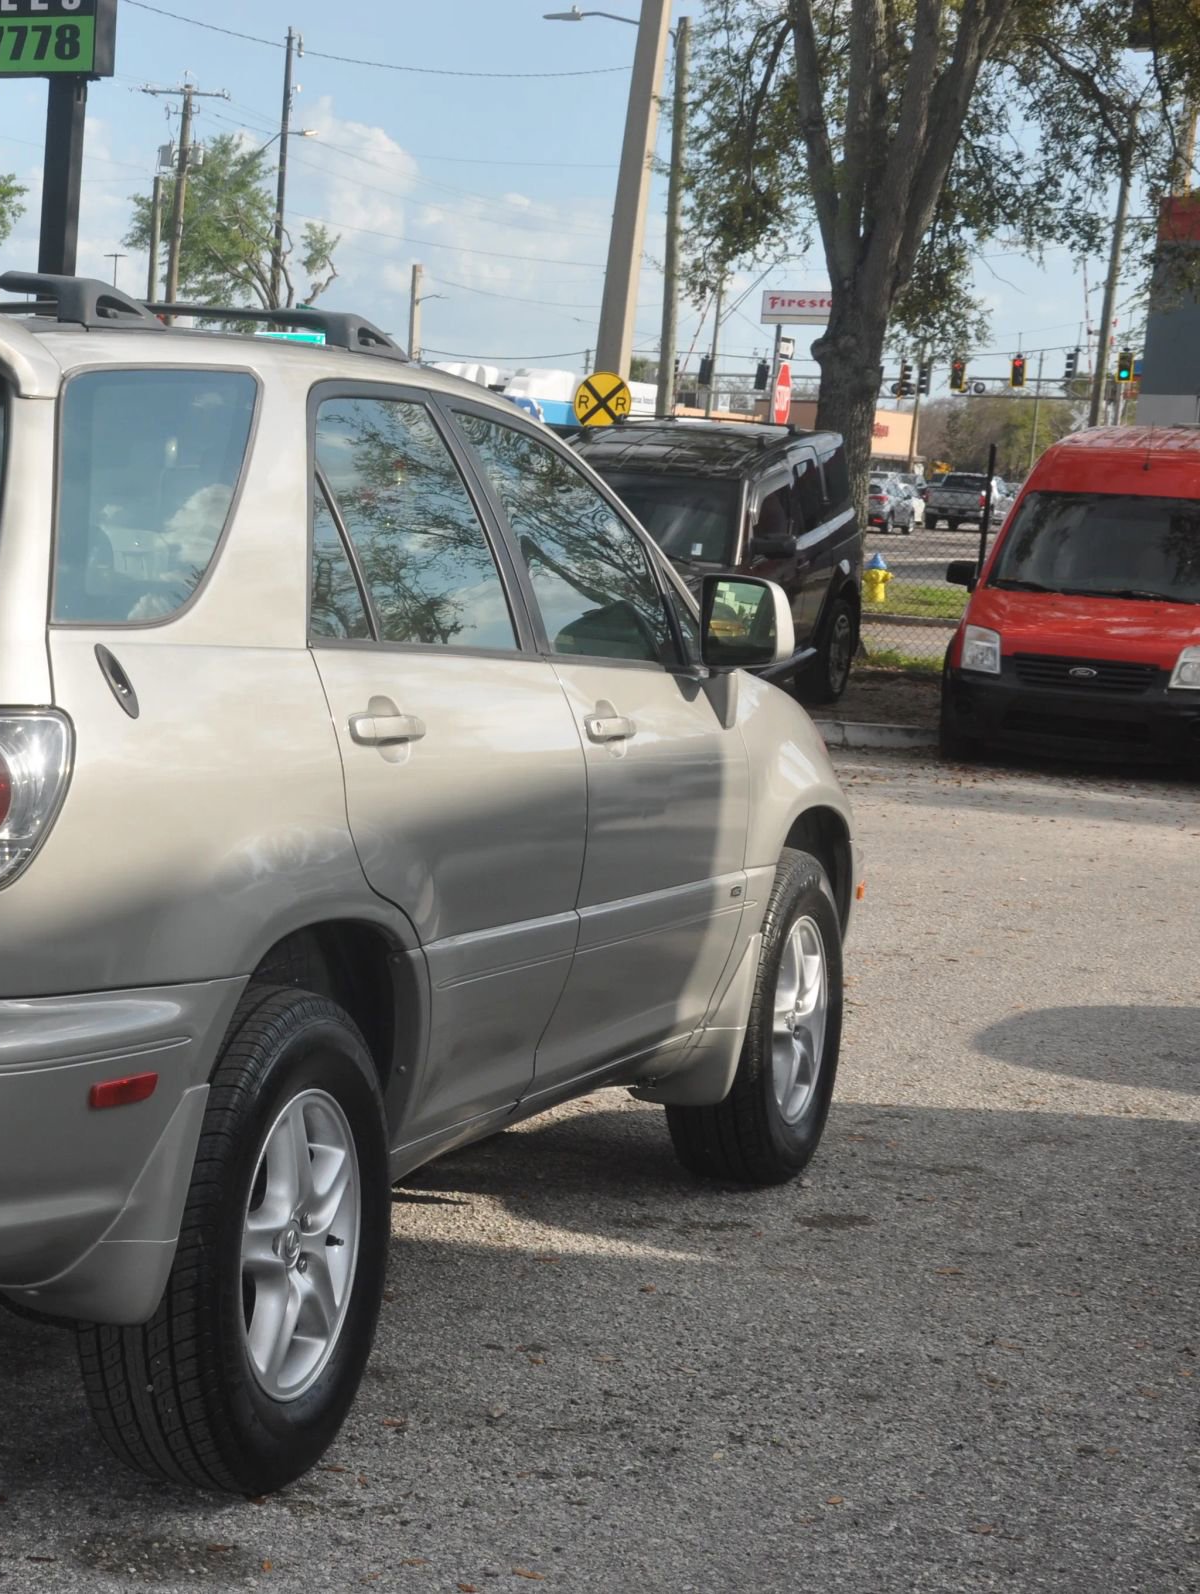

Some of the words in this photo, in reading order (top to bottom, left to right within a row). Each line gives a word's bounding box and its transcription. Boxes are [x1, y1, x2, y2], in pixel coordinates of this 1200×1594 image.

[768, 296, 833, 310] Firesto
[578, 394, 590, 409] R
[615, 397, 627, 411] R
